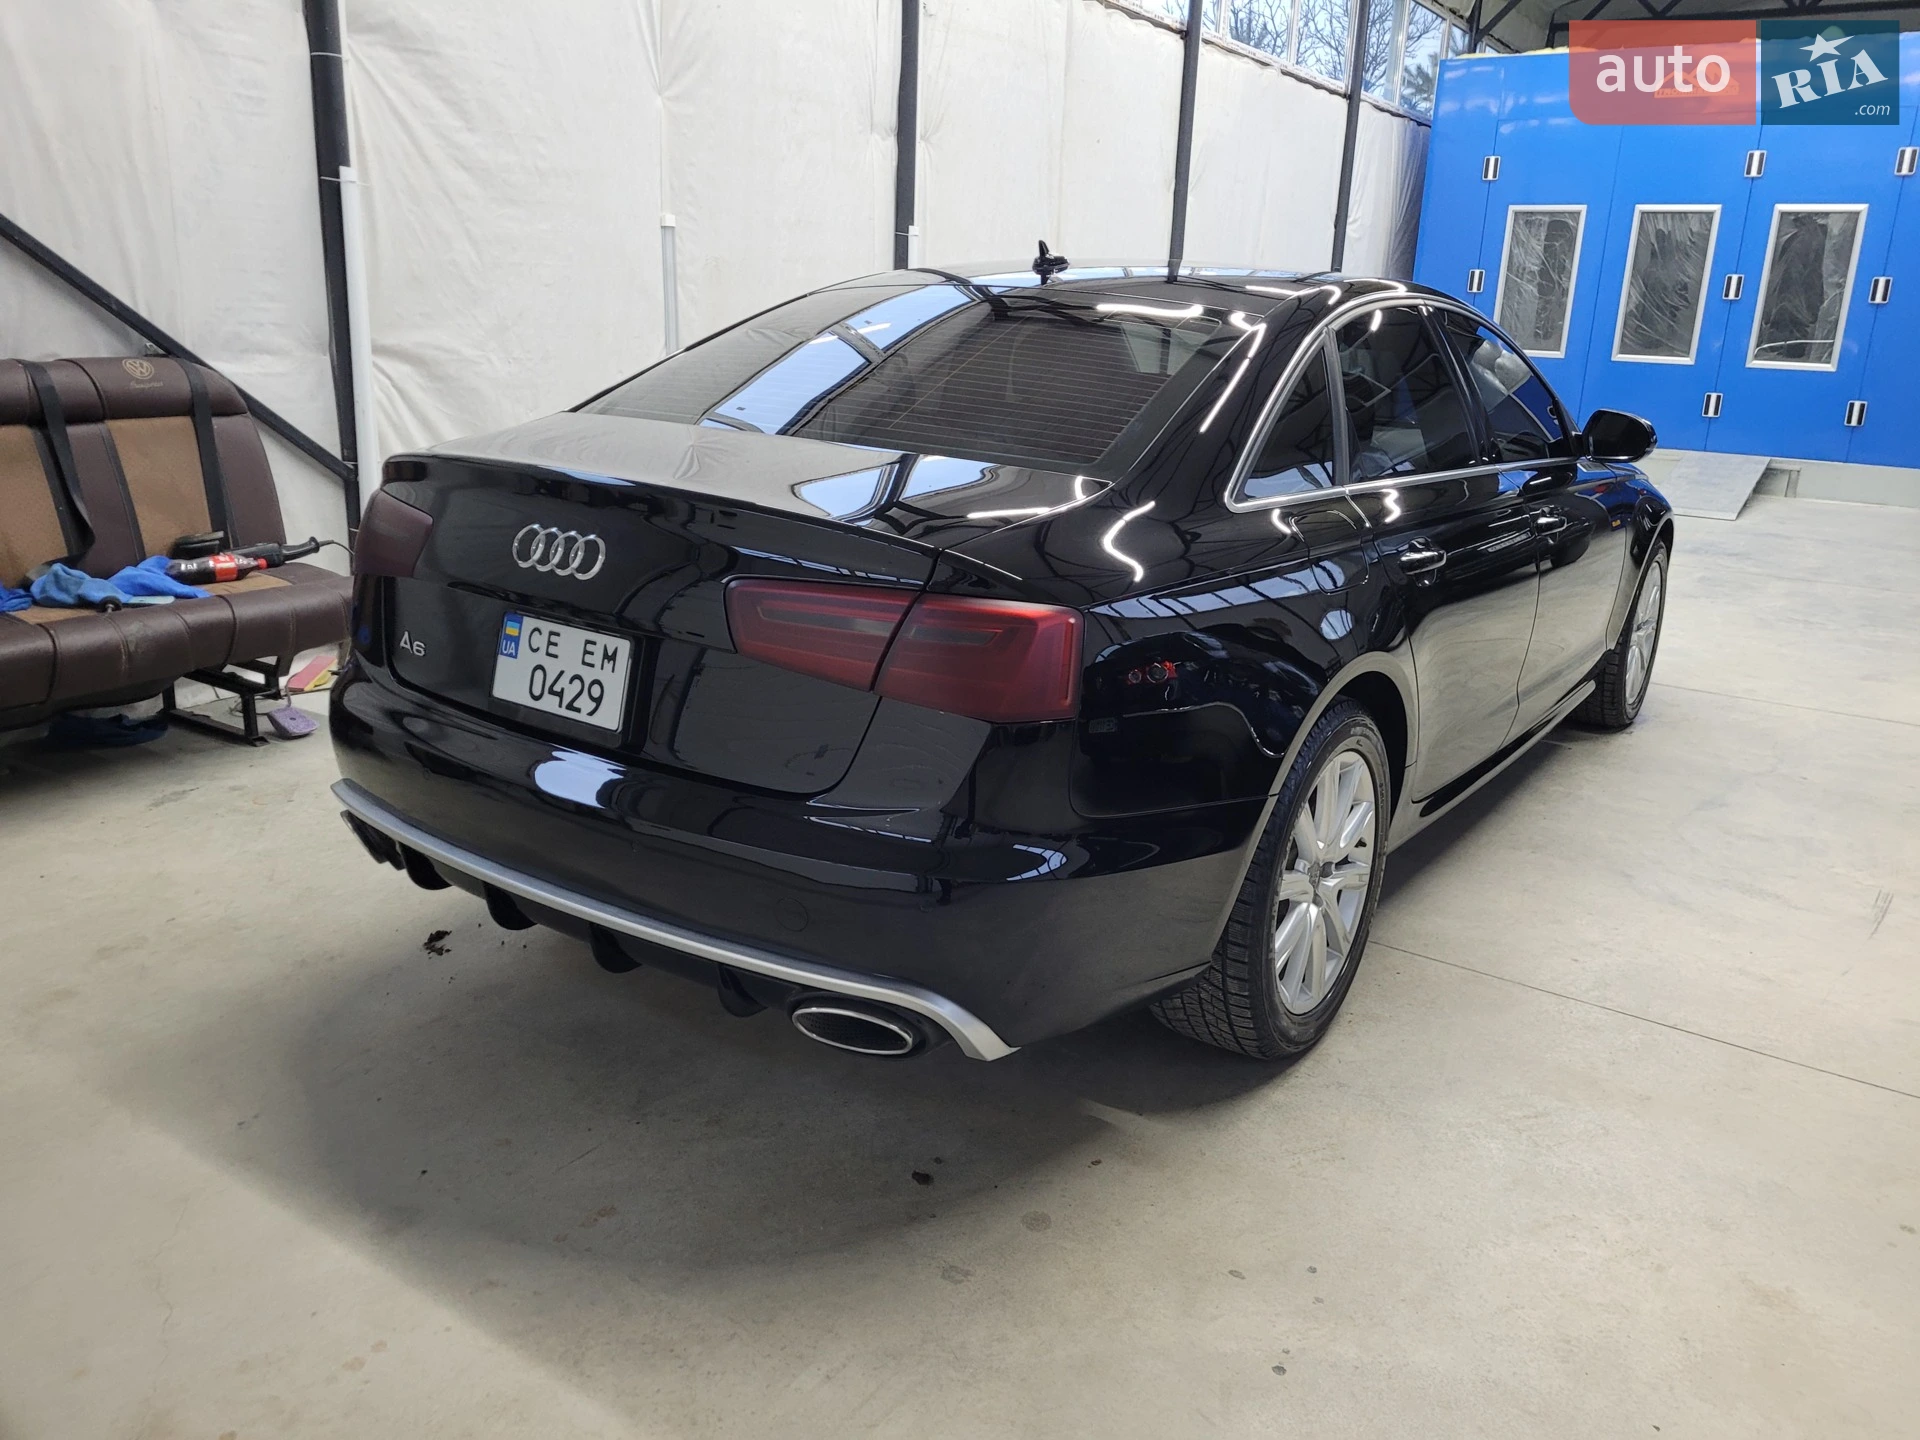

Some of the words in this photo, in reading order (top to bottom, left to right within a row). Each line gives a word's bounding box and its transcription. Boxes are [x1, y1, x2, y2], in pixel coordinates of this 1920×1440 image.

[400, 631, 427, 657] A6
[502, 640, 517, 656] UA
[528, 627, 561, 659] CE
[581, 639, 619, 673] EM
[528, 664, 605, 717] 0429
